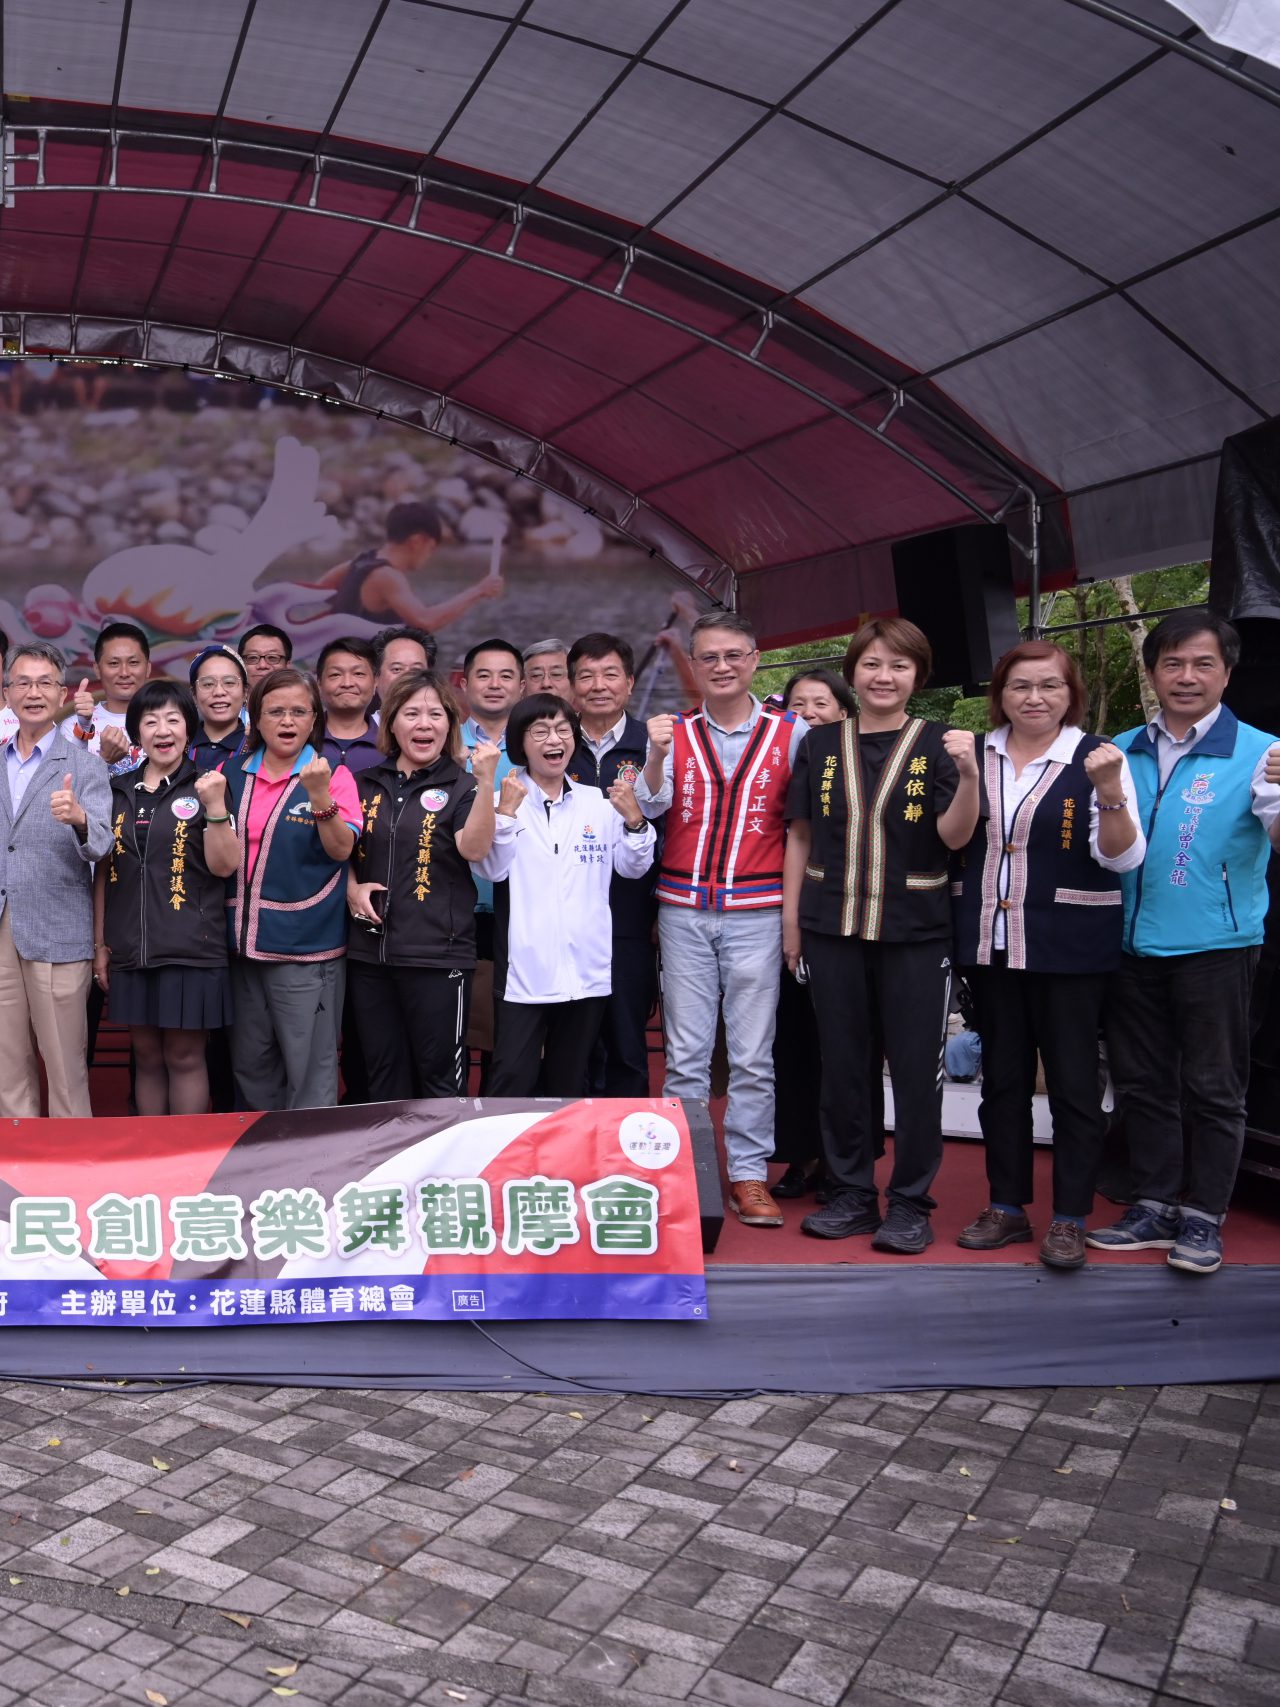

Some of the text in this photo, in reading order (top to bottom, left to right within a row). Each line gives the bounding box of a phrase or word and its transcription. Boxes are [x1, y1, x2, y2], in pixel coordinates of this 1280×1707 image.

[681, 757, 696, 824] 花蓮縣議會
[747, 768, 771, 835] 李正文
[820, 756, 837, 817] 花蓮縣議員
[904, 756, 927, 823] 蔡依靜
[169, 820, 188, 911] 花蓮縣議會
[413, 812, 436, 902] 花蓮縣議會
[1170, 834, 1194, 887] 曾金龍
[61, 1284, 416, 1317] 主辦單位：花蓮縣體育總會
[456, 1292, 481, 1310] 廣告
